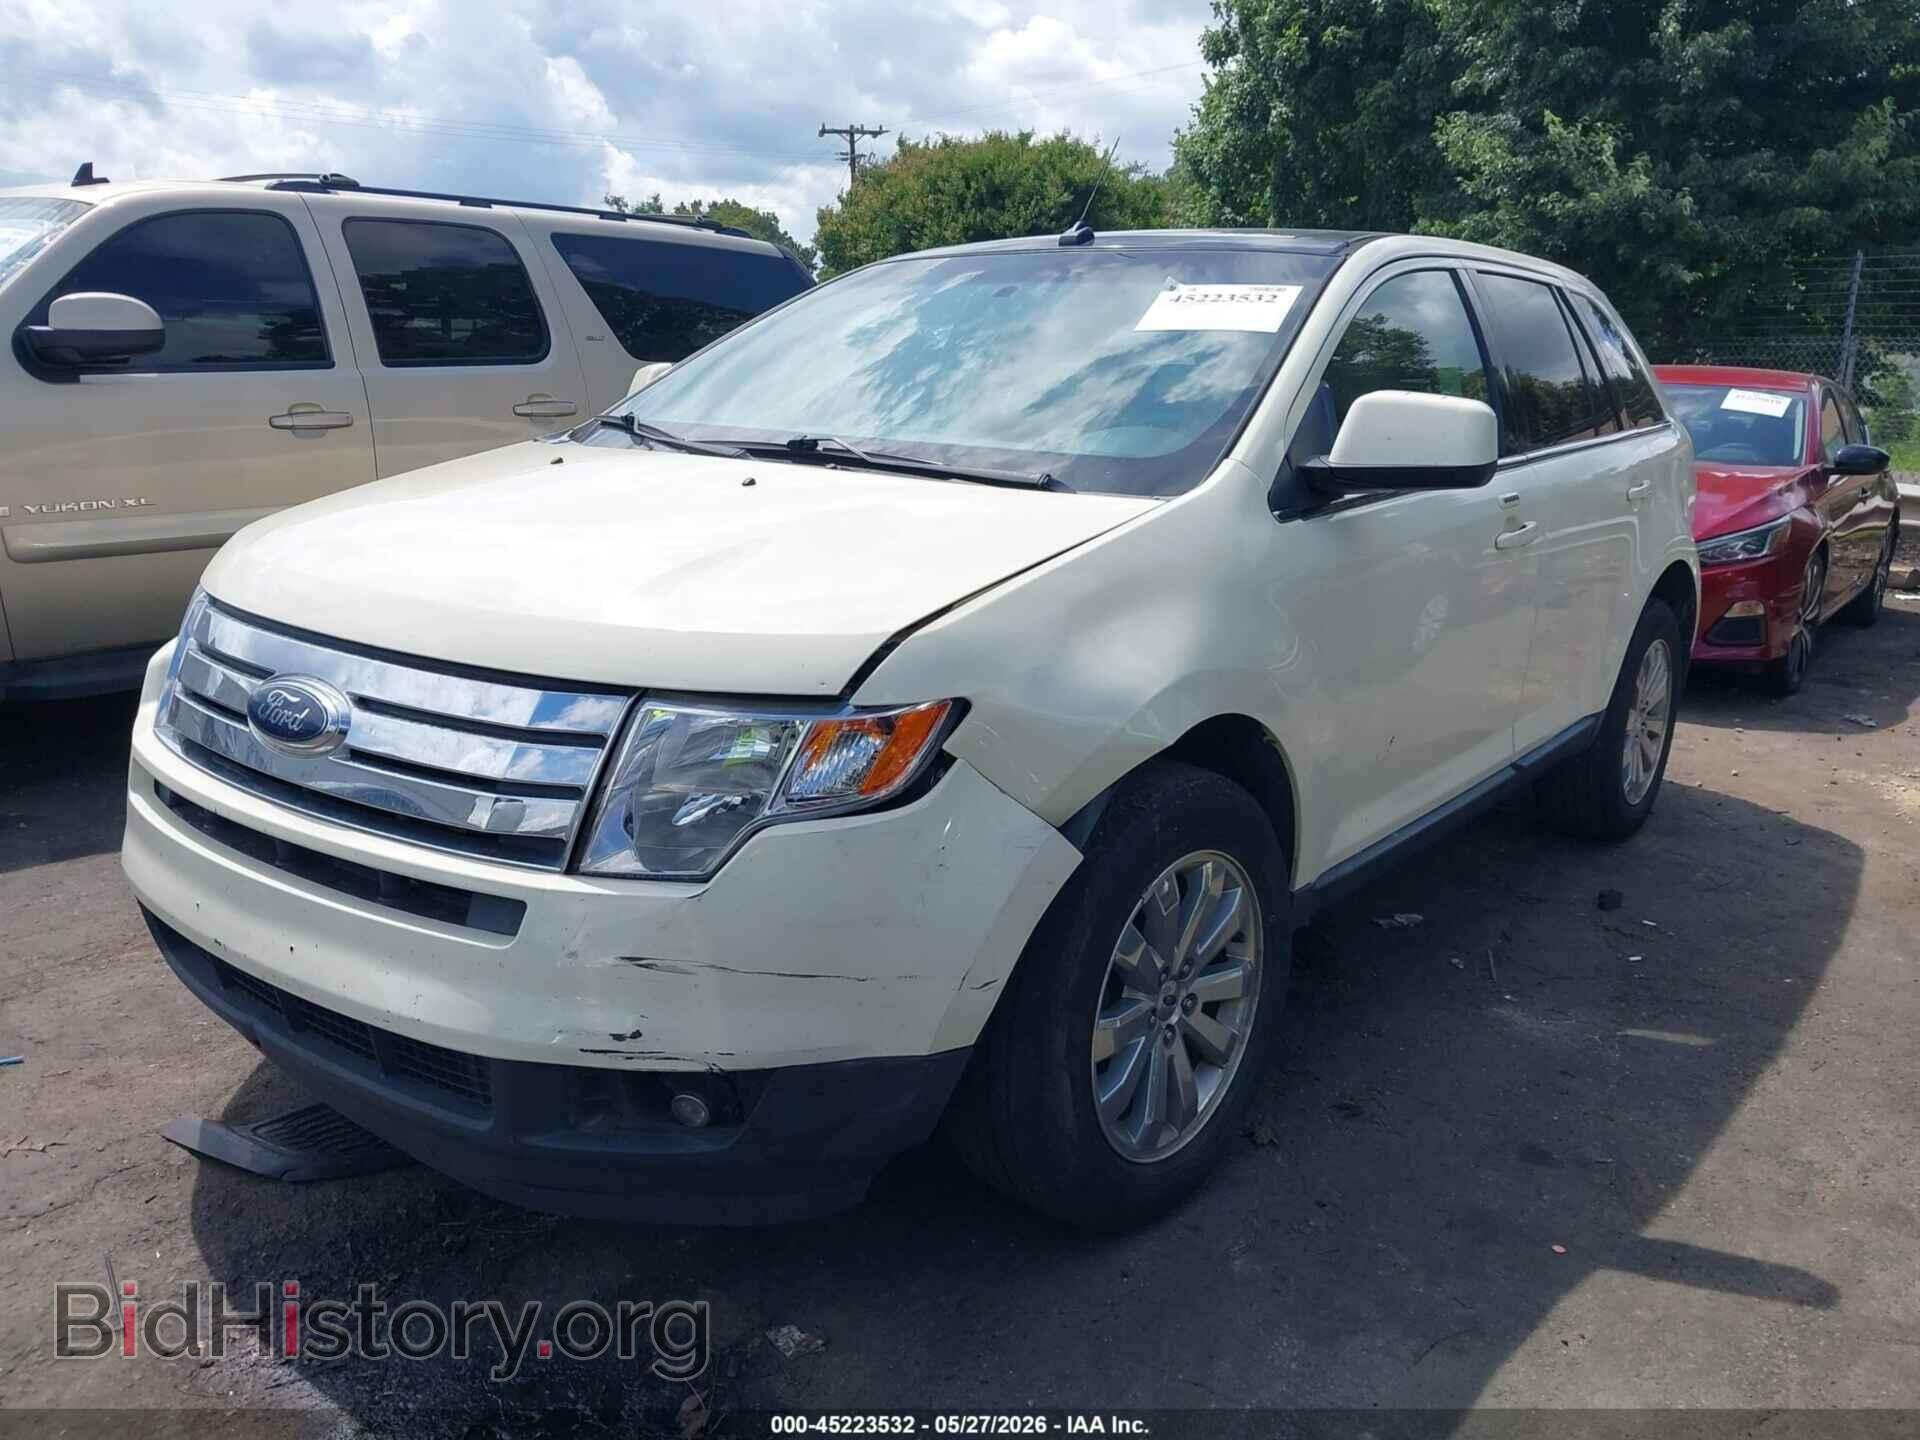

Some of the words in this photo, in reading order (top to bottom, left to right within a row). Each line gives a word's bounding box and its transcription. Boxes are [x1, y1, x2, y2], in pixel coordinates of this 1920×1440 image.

[1169, 293, 1278, 303] 45223532
[24, 499, 115, 514] YUKON
[120, 497, 156, 507] XL
[258, 689, 310, 731] Ford
